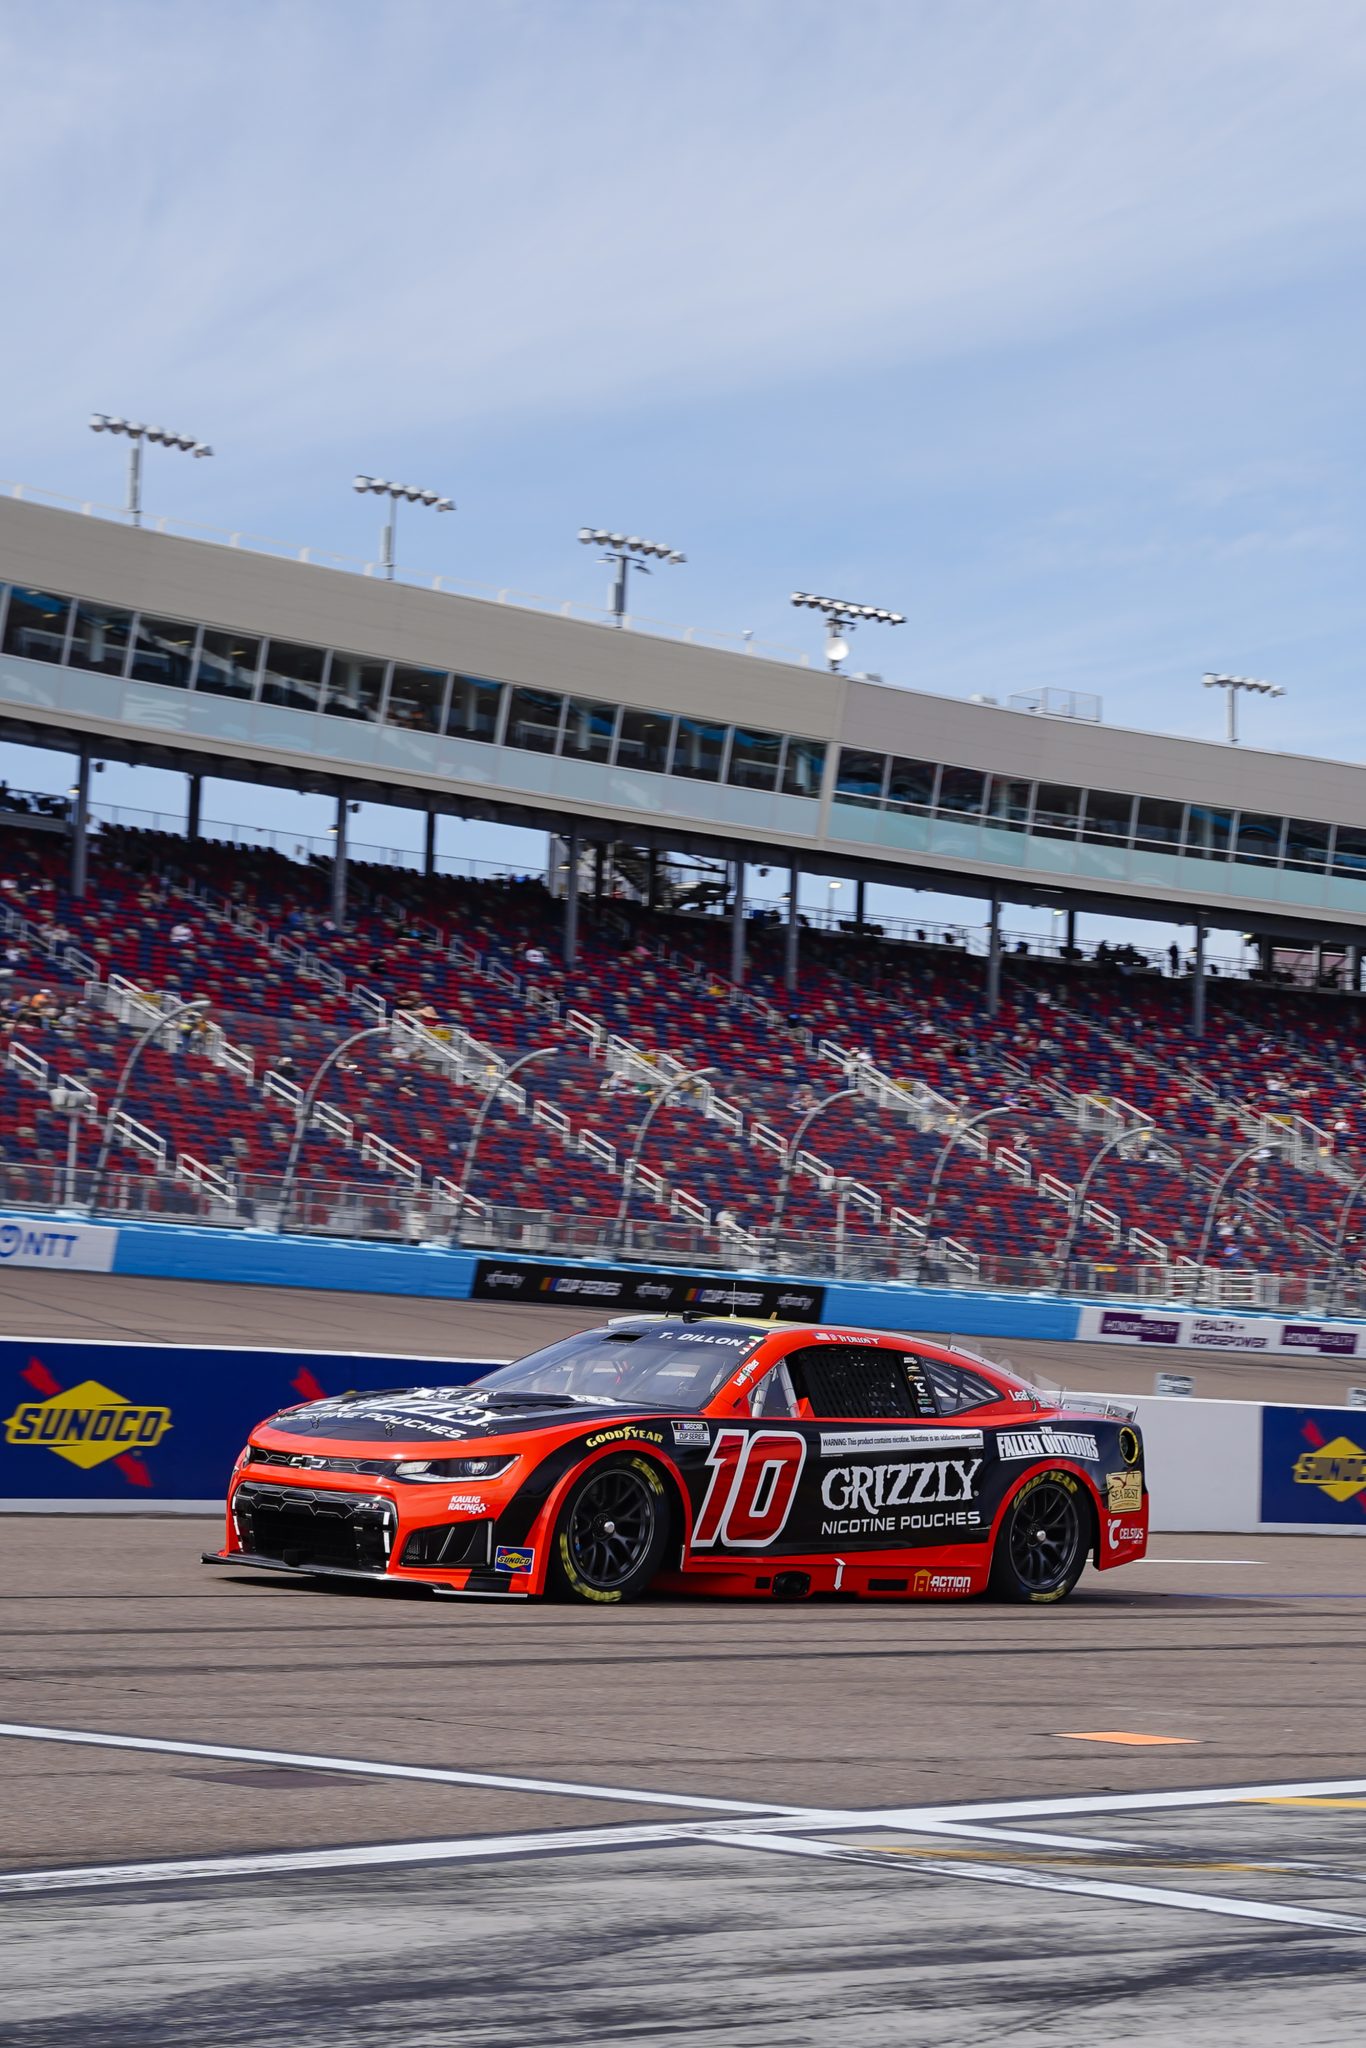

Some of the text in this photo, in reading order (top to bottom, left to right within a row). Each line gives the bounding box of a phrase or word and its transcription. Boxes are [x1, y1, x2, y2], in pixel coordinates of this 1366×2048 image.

[22, 1232, 79, 1257] NTT
[677, 1333, 745, 1347] DILLON
[12, 1407, 164, 1442] SUNOCO
[360, 1412, 467, 1439] POUCHES
[585, 1426, 664, 1448] GOODYEAR
[848, 1437, 857, 1445] This
[858, 1436, 874, 1446] product
[874, 1436, 892, 1444] contains
[910, 1434, 929, 1442] Nicotine
[997, 1434, 1099, 1459] FALLEN OUTDOORS
[690, 1428, 807, 1548] 10
[821, 1459, 983, 1515] GRIZZLY
[1110, 1489, 1138, 1501] SEA BEST
[448, 1503, 480, 1511] RACING
[821, 1511, 981, 1535] NICOTINE POUCHES
[499, 1556, 530, 1565] SUNOCO
[930, 1576, 971, 1587] ACTION
